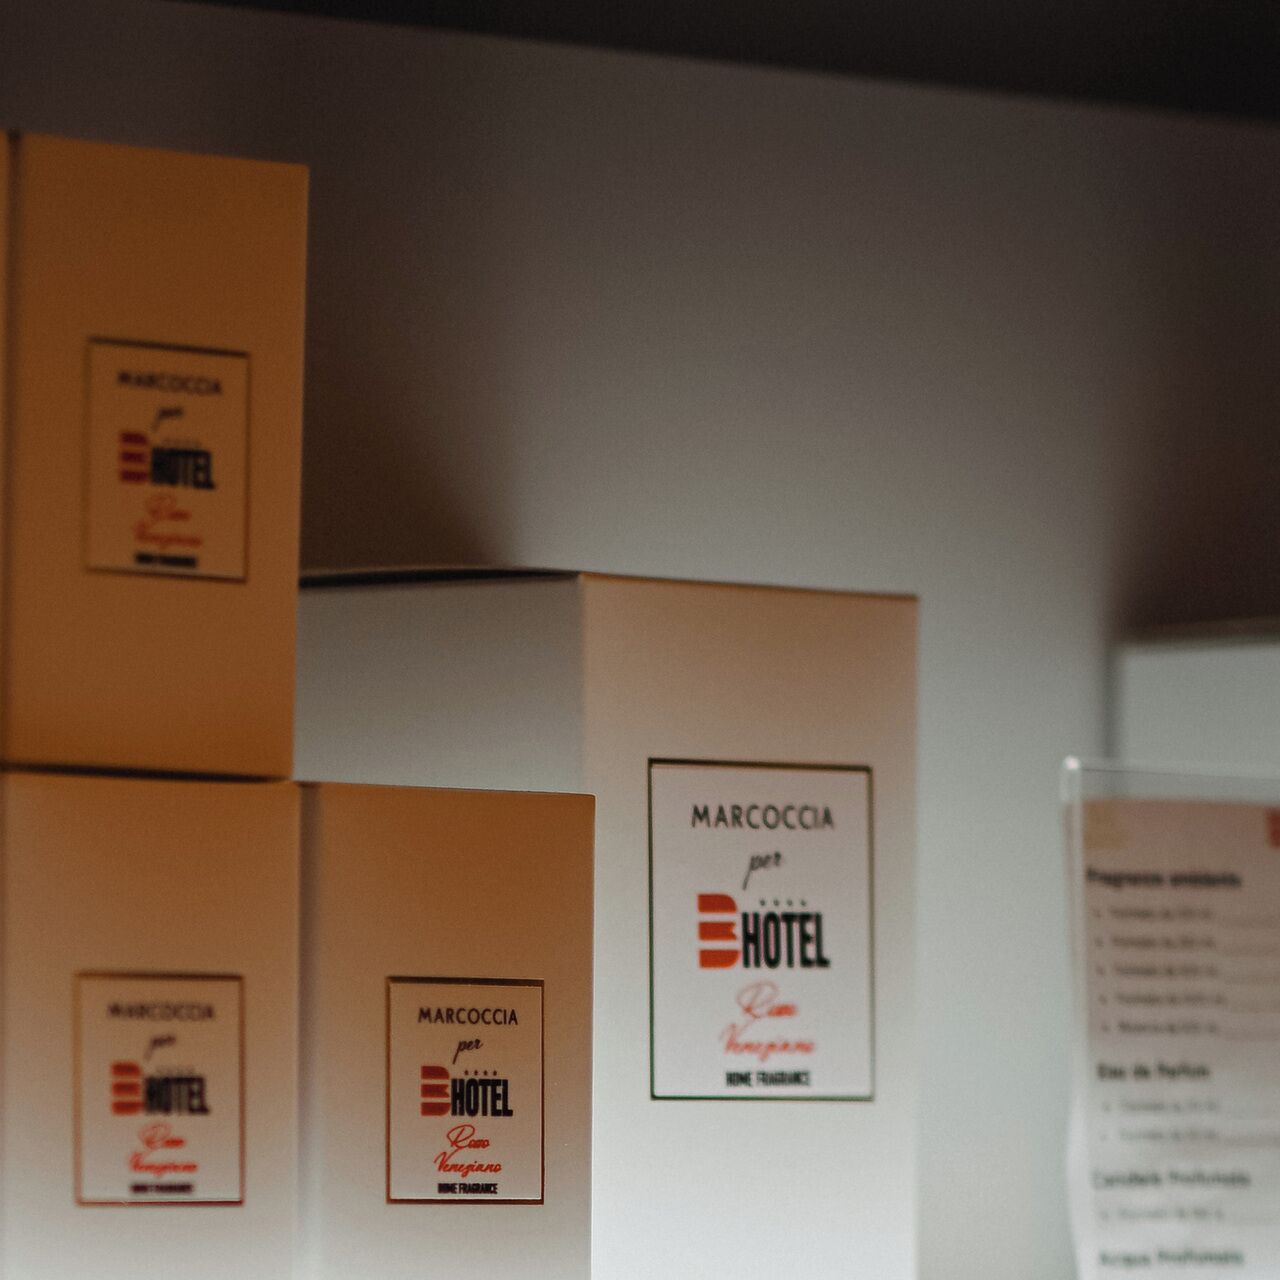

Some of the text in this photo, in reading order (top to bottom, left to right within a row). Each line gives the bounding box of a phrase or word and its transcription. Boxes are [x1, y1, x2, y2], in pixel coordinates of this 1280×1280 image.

[691, 804, 835, 830] MARCOCCIA
[742, 851, 782, 891] per
[742, 912, 831, 970] HOTEL
[418, 1007, 518, 1026] MARCOCCIA
[453, 1038, 483, 1064] per
[451, 1078, 513, 1117] HOTEL
